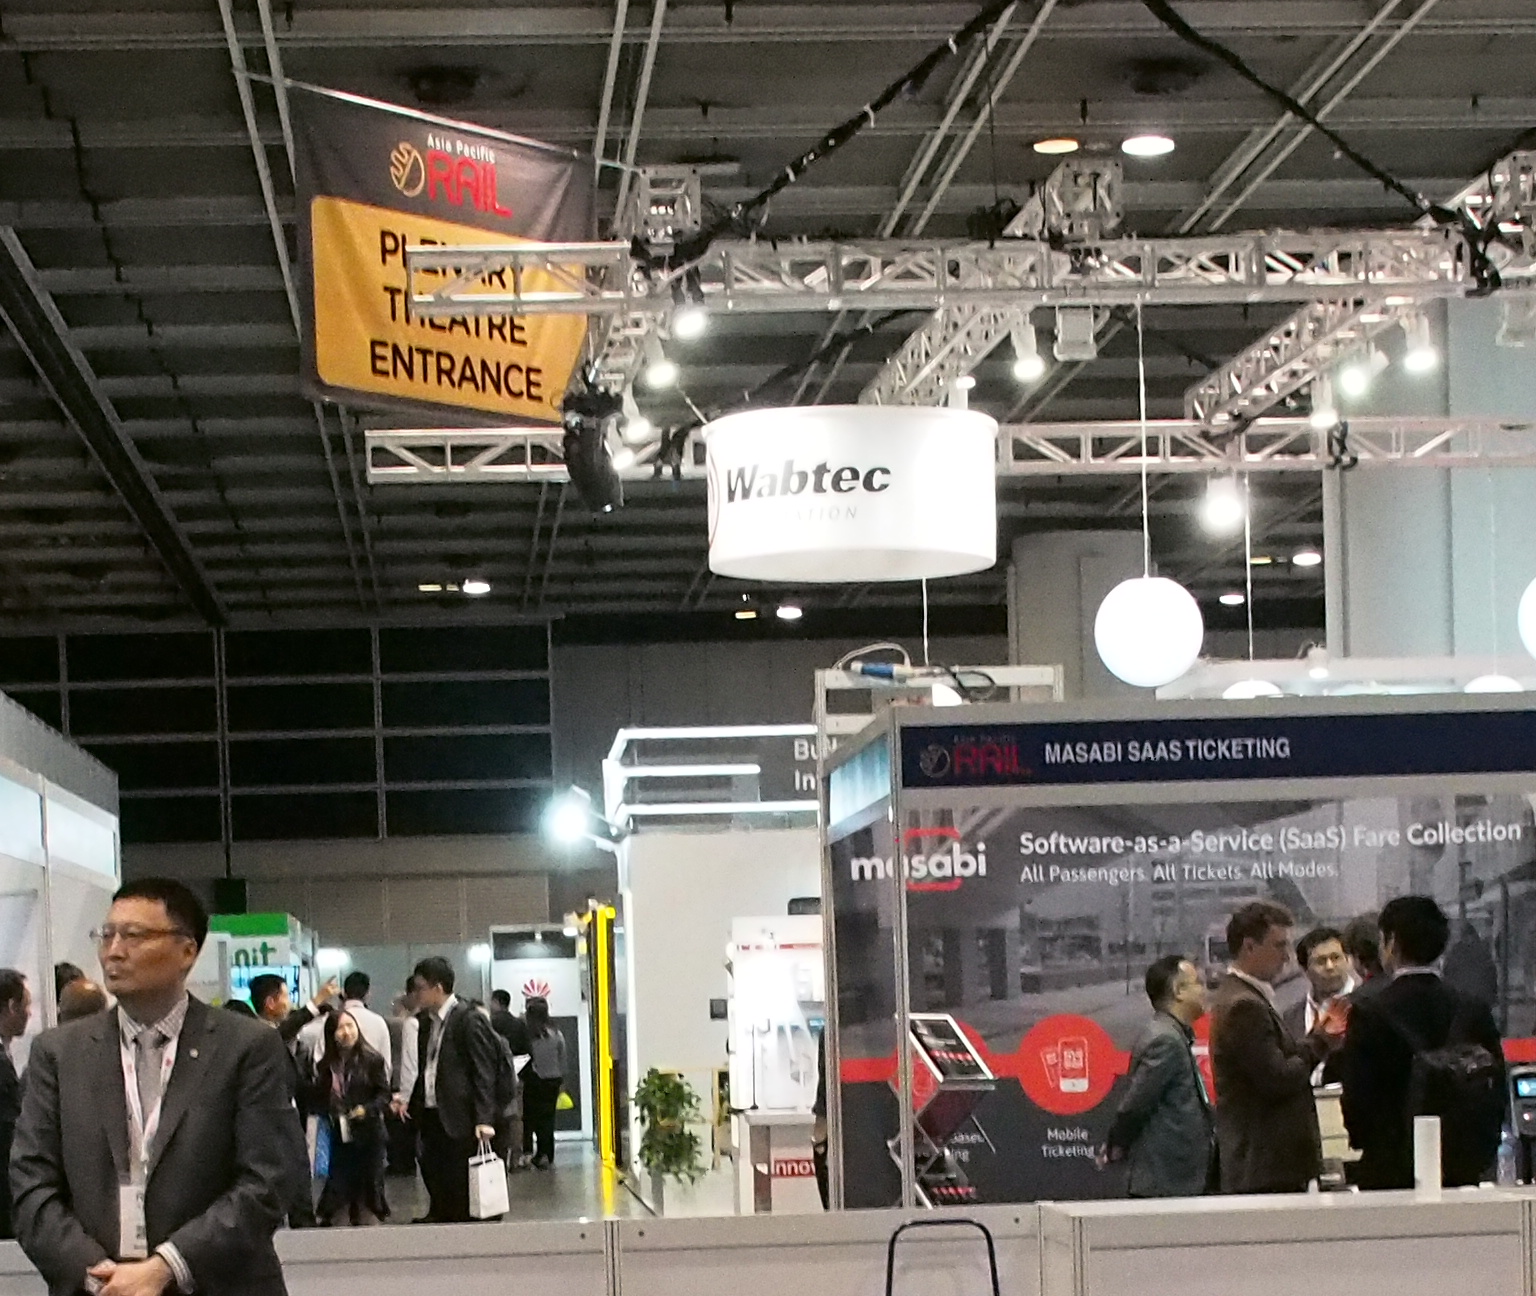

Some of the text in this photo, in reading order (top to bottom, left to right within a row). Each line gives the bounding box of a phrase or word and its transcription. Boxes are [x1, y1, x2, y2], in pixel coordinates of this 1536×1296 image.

[427, 133, 496, 164] Asia Pacific
[427, 150, 512, 218] RAIL
[370, 341, 543, 404] ENTRANCE
[727, 460, 891, 503] Wabtec
[1045, 738, 1291, 765] MASABI SAAS TICKETING
[1020, 821, 1521, 854] Software-as-a-Service (SaaS) Fare Collection
[851, 842, 987, 882] masabi
[1021, 866, 1045, 883] All
[1153, 863, 1176, 881] All
[1251, 862, 1274, 879] All
[1047, 1127, 1088, 1141] Mobile
[1042, 1145, 1094, 1160] Ticketing
